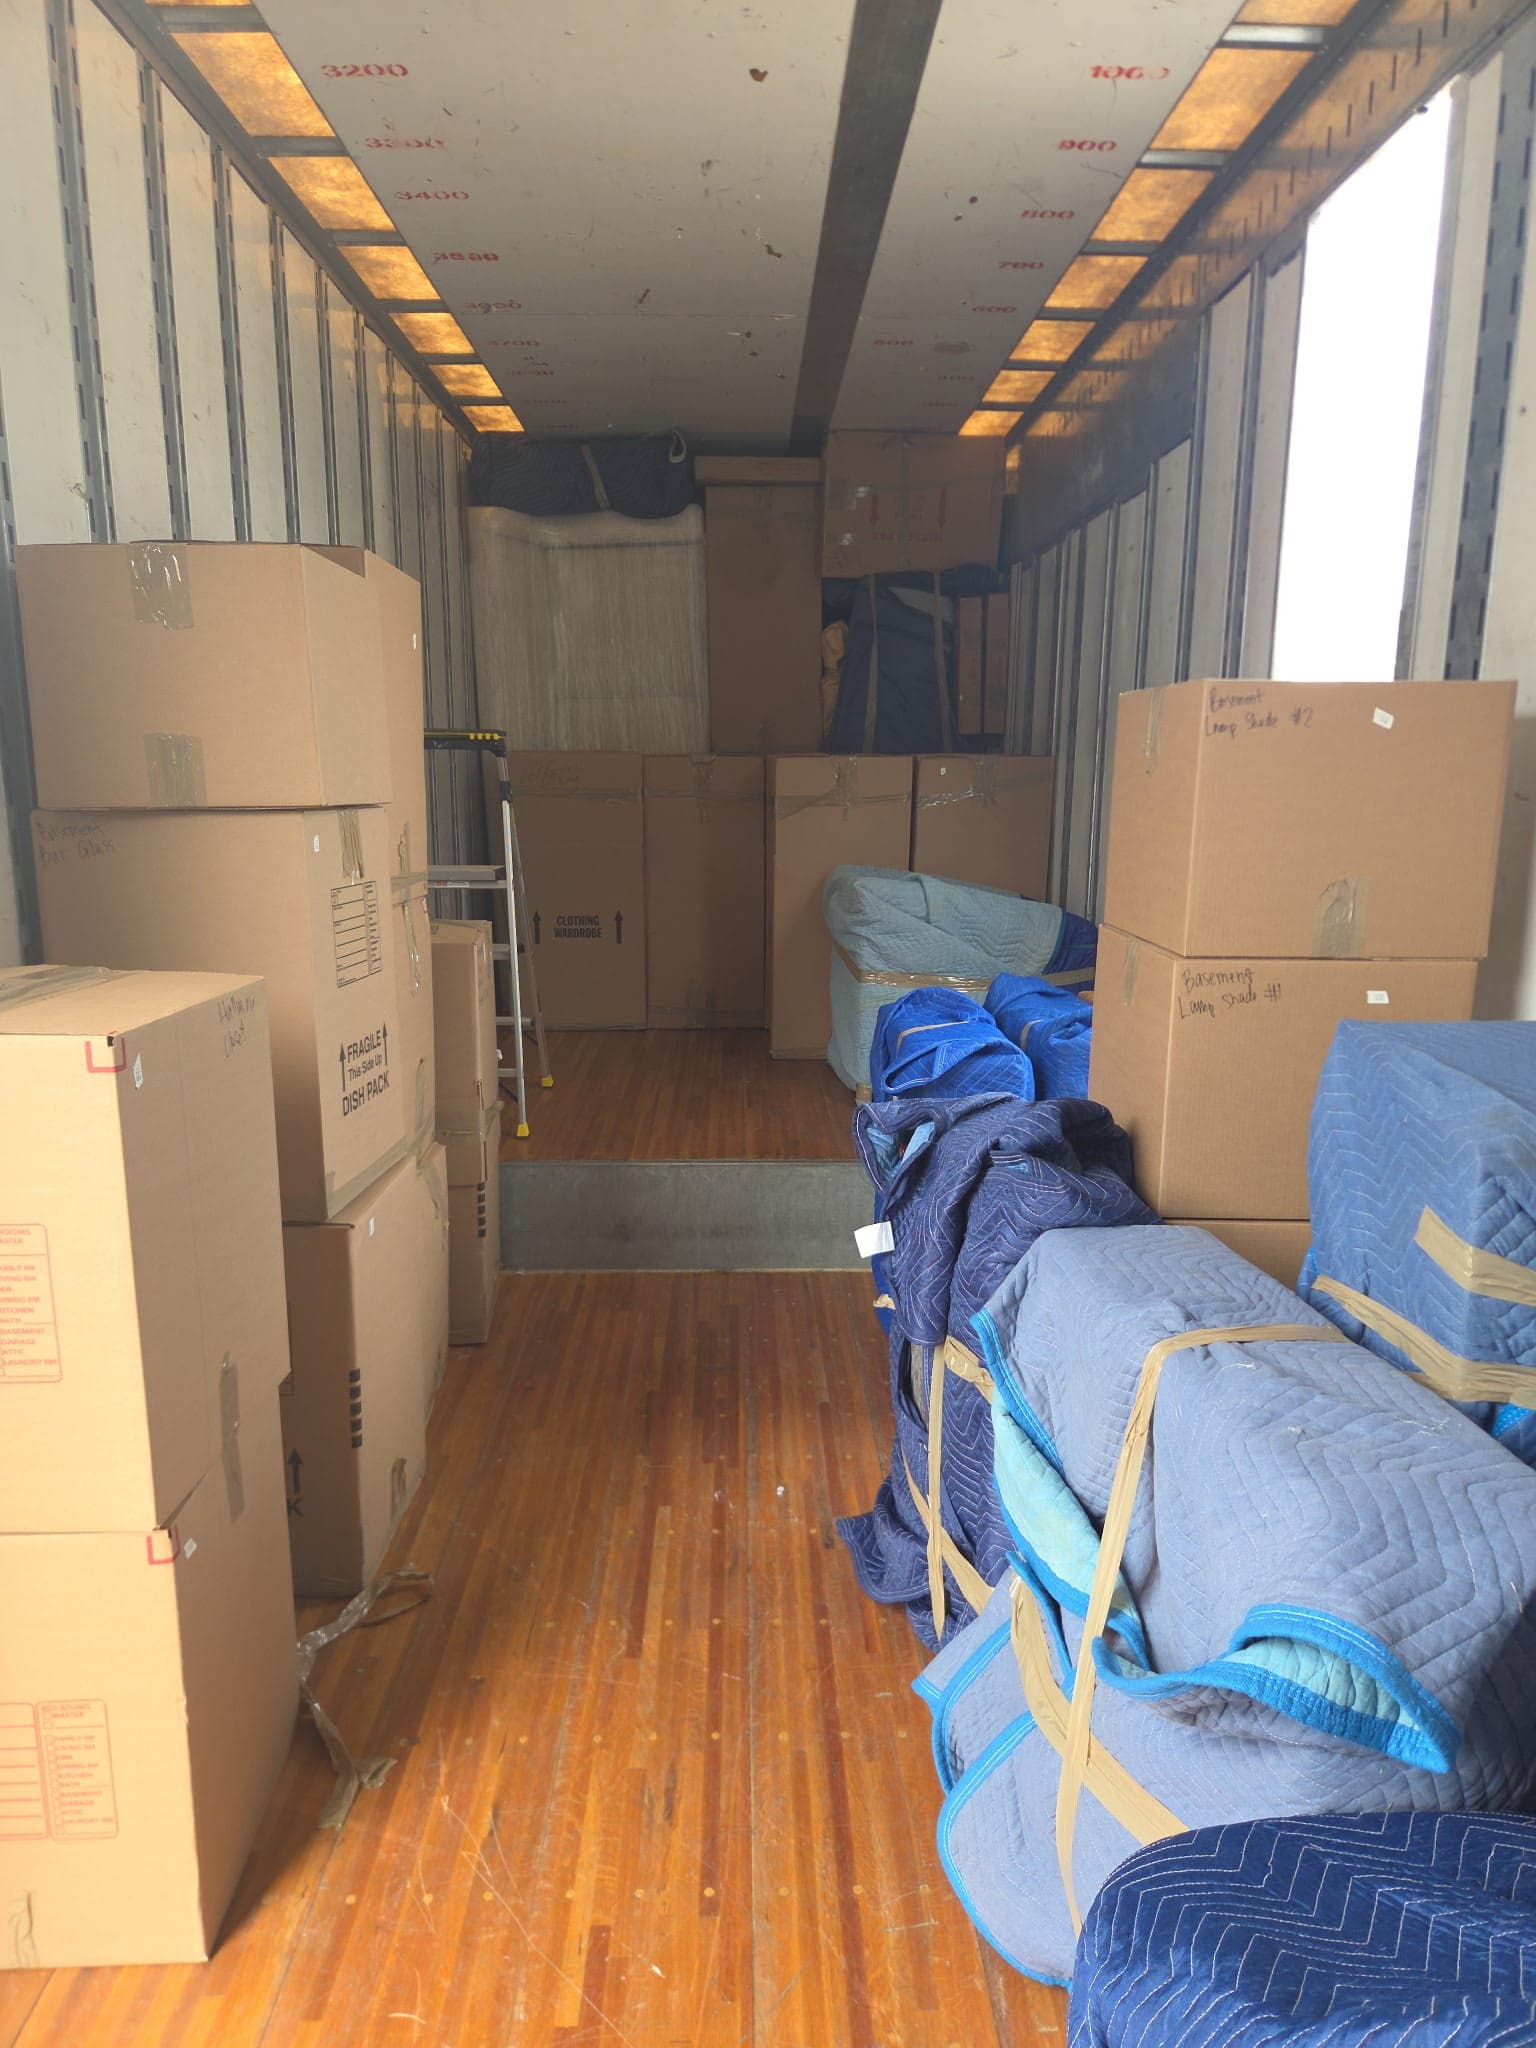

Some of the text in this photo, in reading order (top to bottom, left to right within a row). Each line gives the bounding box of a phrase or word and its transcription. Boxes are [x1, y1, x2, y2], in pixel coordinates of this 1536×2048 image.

[320, 63, 408, 78] 3200
[394, 191, 470, 200] 3400
[1205, 714, 1236, 738] Lamp
[1291, 706, 1314, 729] #2
[553, 927, 603, 938] WARDROBE
[556, 915, 600, 926] CLOTHING
[1182, 968, 1255, 993] Basement
[1178, 995, 1215, 1020] Lamp
[347, 1029, 382, 1063] FRAGILE
[348, 1052, 383, 1081] This Side Up
[342, 1070, 390, 1117] DISH PACK
